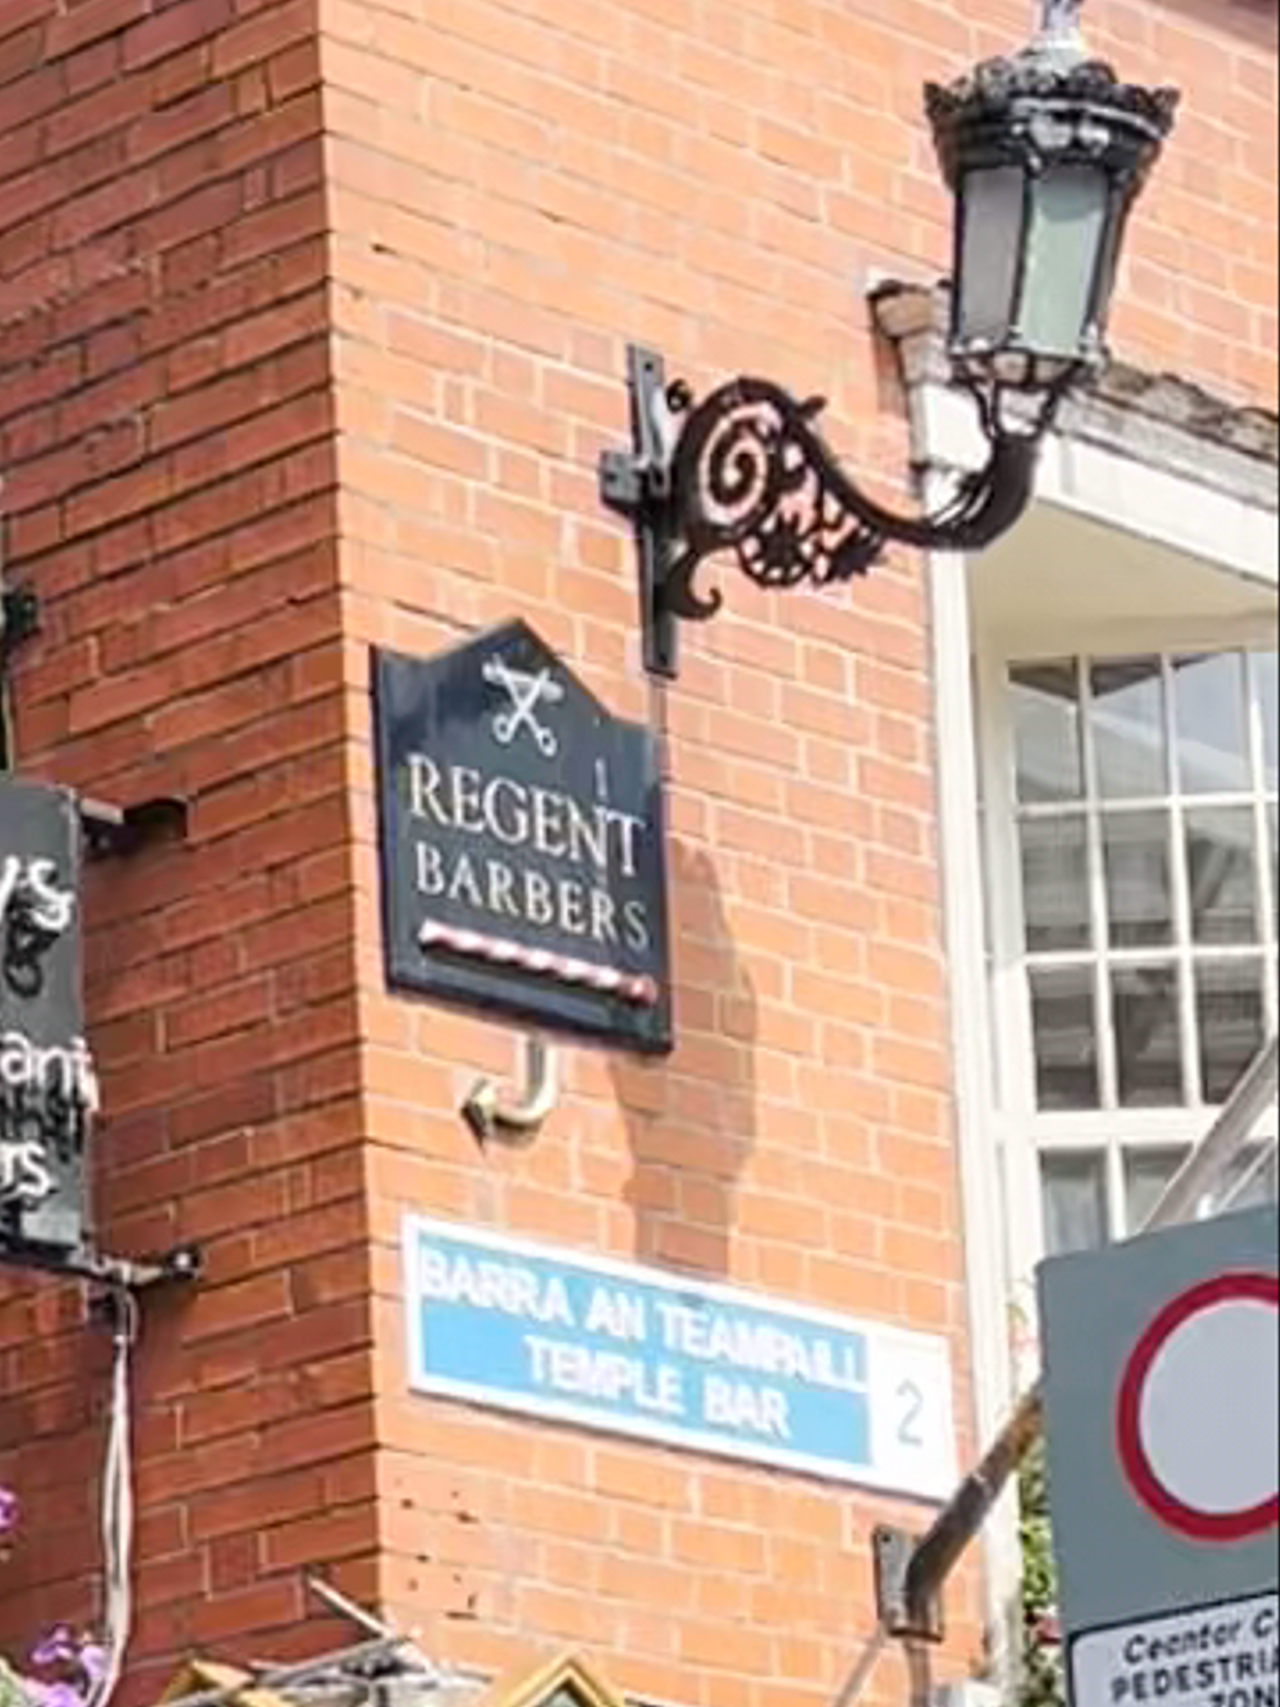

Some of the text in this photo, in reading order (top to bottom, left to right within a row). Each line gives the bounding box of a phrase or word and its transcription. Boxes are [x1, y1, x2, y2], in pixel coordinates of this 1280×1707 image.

[407, 753, 646, 876] REGENT
[416, 841, 648, 951] BARBERS
[417, 1249, 574, 1327] BARRA
[584, 1290, 642, 1342] AN
[523, 1333, 791, 1439] TEMPLE BAR
[897, 1377, 925, 1446] 2
[1251, 1607, 1278, 1639] C
